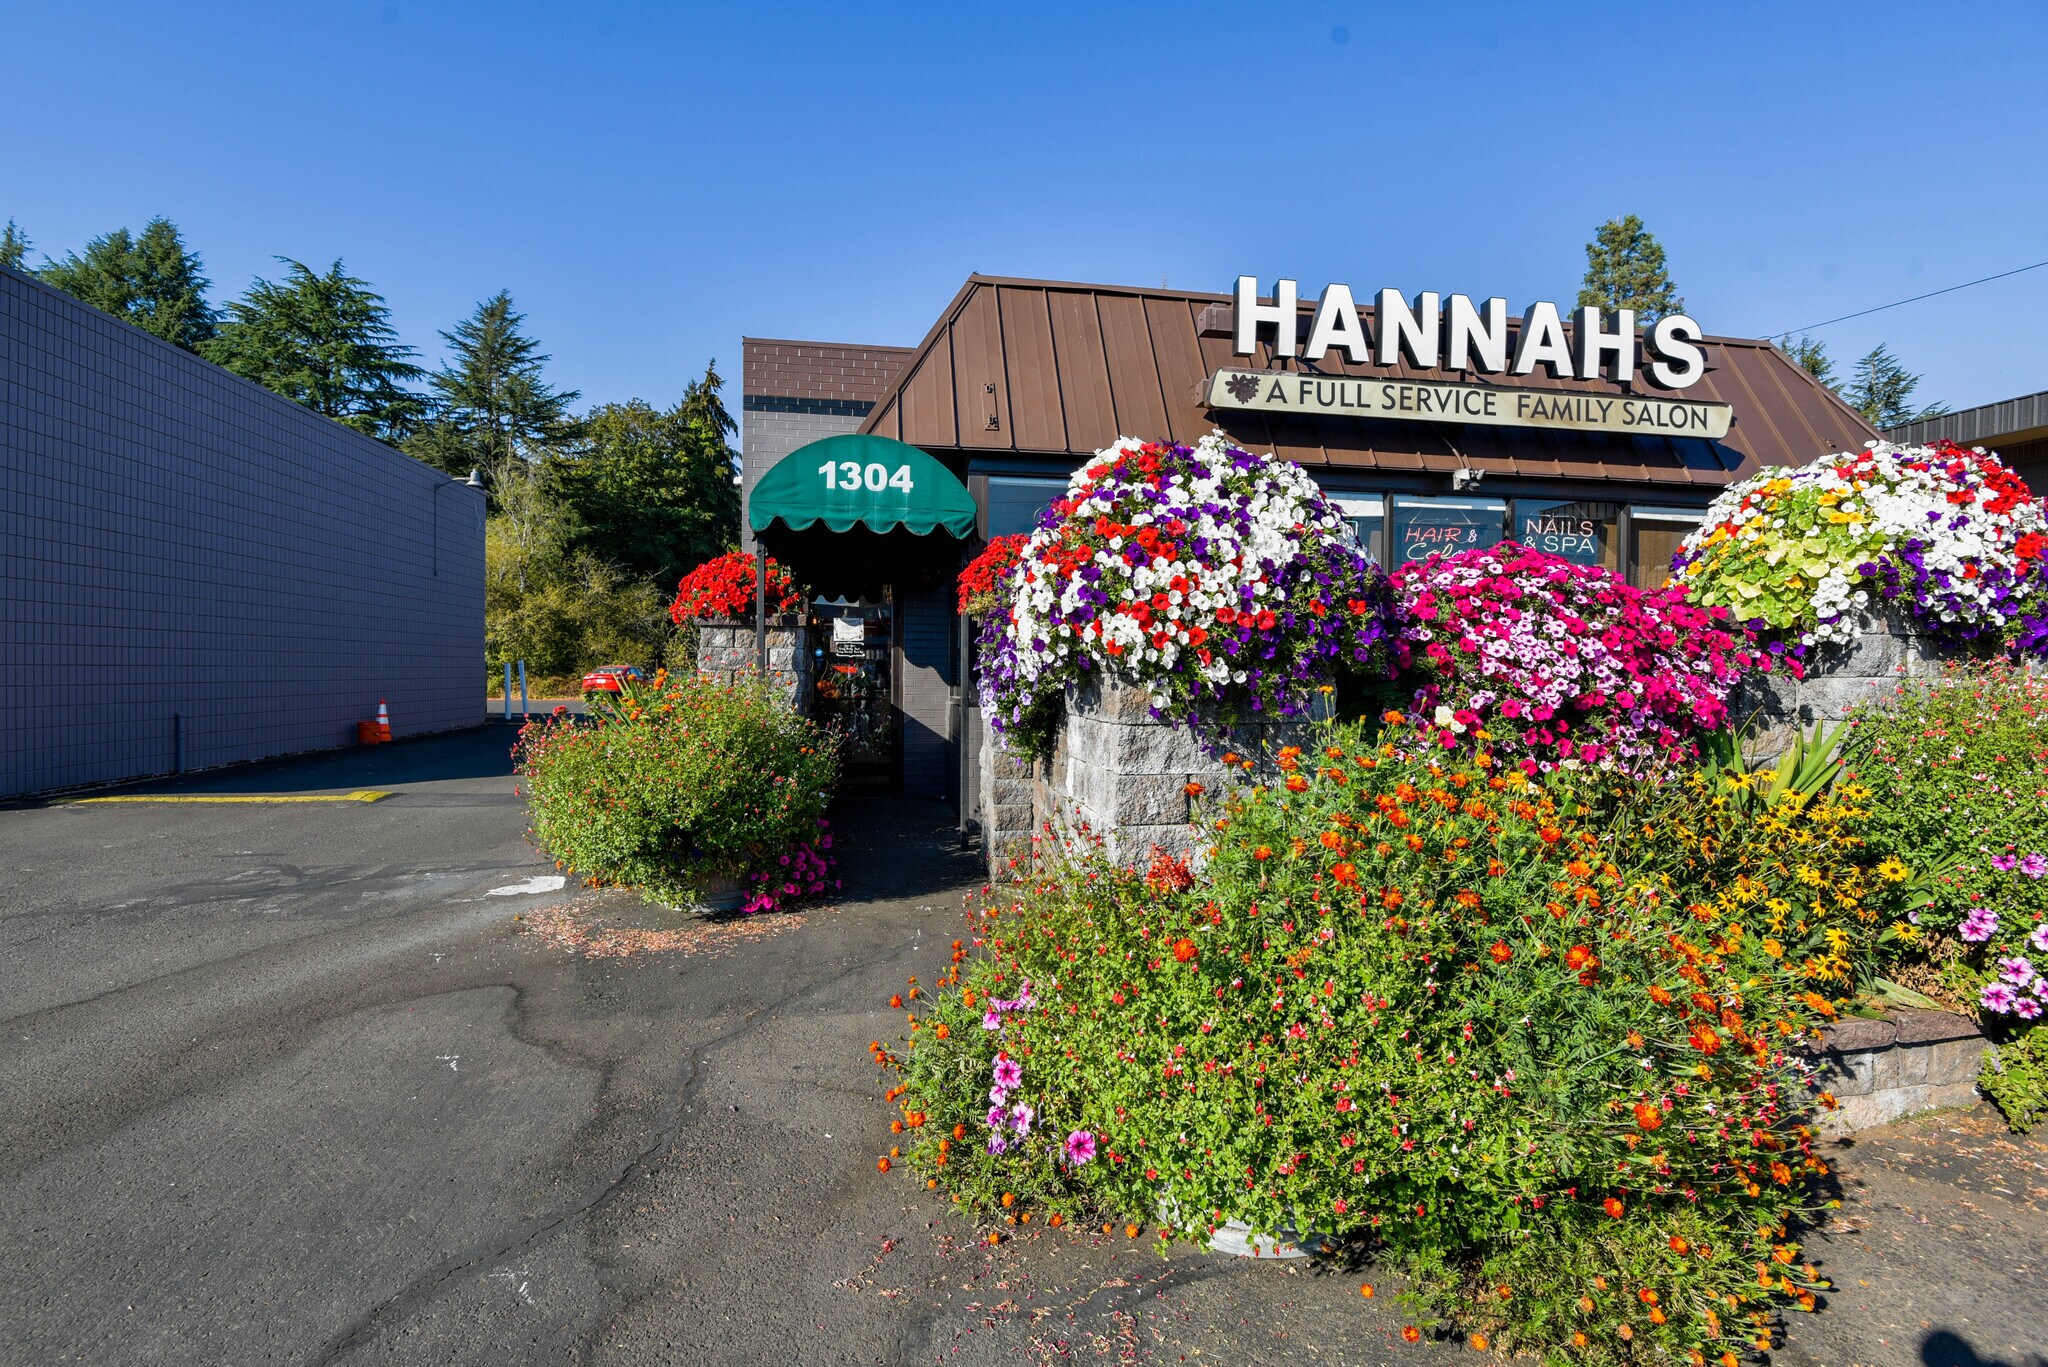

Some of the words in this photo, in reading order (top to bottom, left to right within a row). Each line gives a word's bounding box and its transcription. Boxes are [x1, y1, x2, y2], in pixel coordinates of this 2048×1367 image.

[1233, 275, 1705, 390] HANNAHS
[1265, 378, 1288, 404] A
[1299, 380, 1371, 408] FULL
[1381, 384, 1497, 417] SERVICE
[1517, 394, 1614, 424] FAMILY
[1622, 401, 1708, 430] SALON
[818, 460, 914, 493] 1304
[1404, 527, 1462, 543] HAIR
[1468, 528, 1478, 543] &
[1526, 518, 1594, 537] NAILS
[1523, 536, 1537, 549] &
[1543, 535, 1595, 554] SPA
